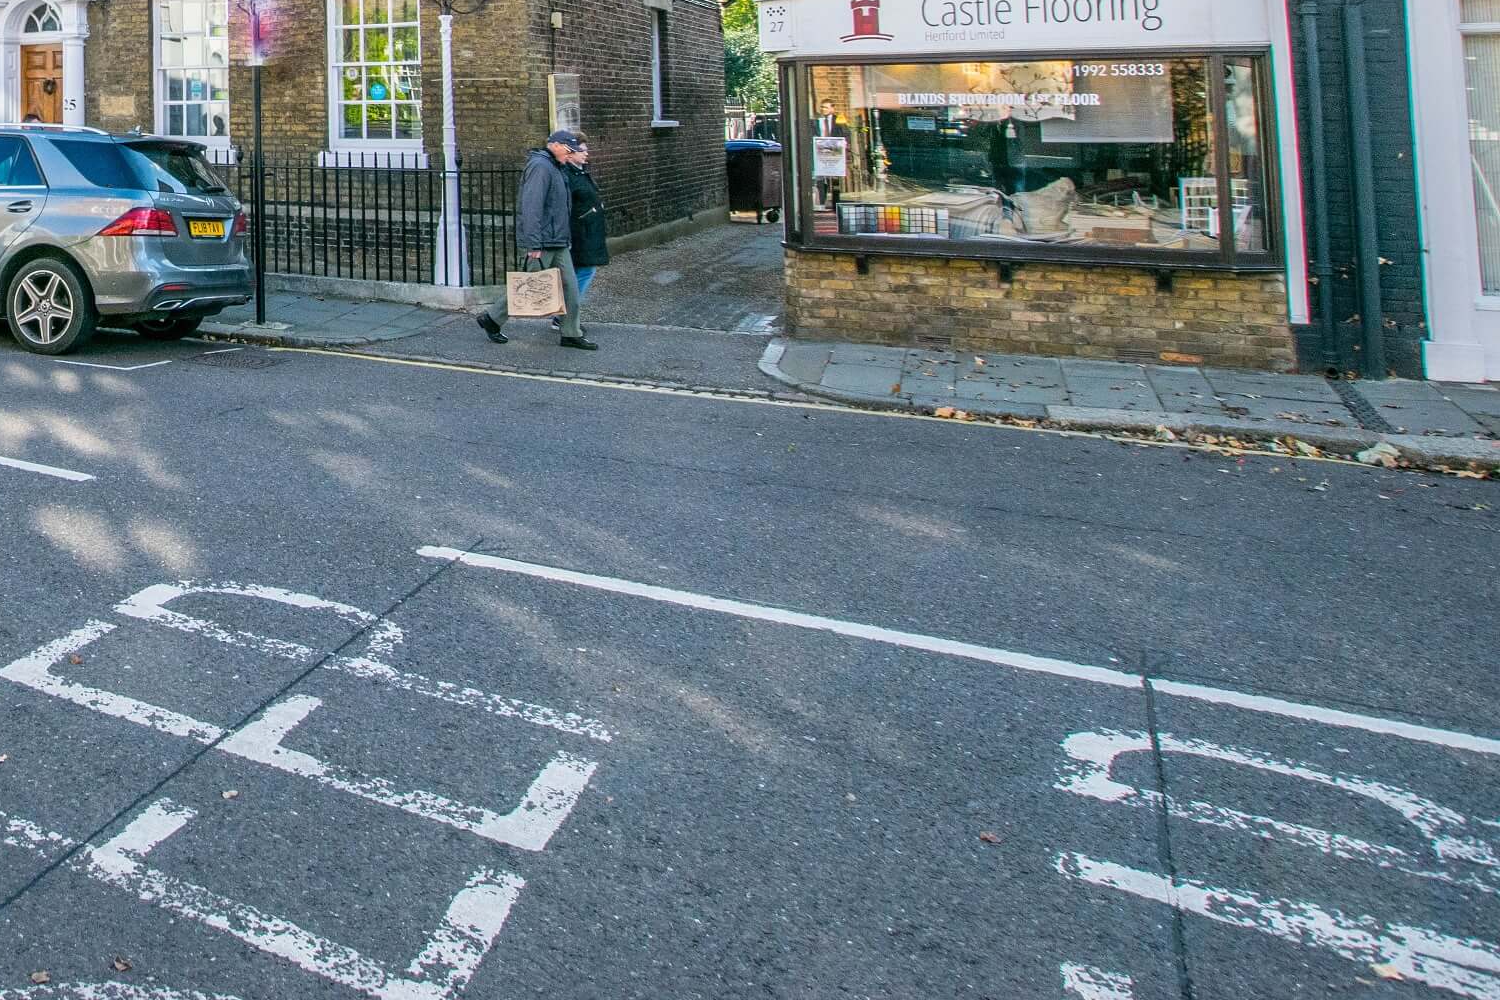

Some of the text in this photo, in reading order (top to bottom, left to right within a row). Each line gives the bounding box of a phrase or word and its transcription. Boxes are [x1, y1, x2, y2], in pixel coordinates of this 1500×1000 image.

[770, 21, 784, 33] 27
[925, 29, 1005, 42] Hertford Limited
[1110, 63, 1165, 76] 558333
[898, 93, 946, 105] BLINDS
[949, 93, 1026, 106] SHOWROOM
[1055, 93, 1101, 106] FLOOR
